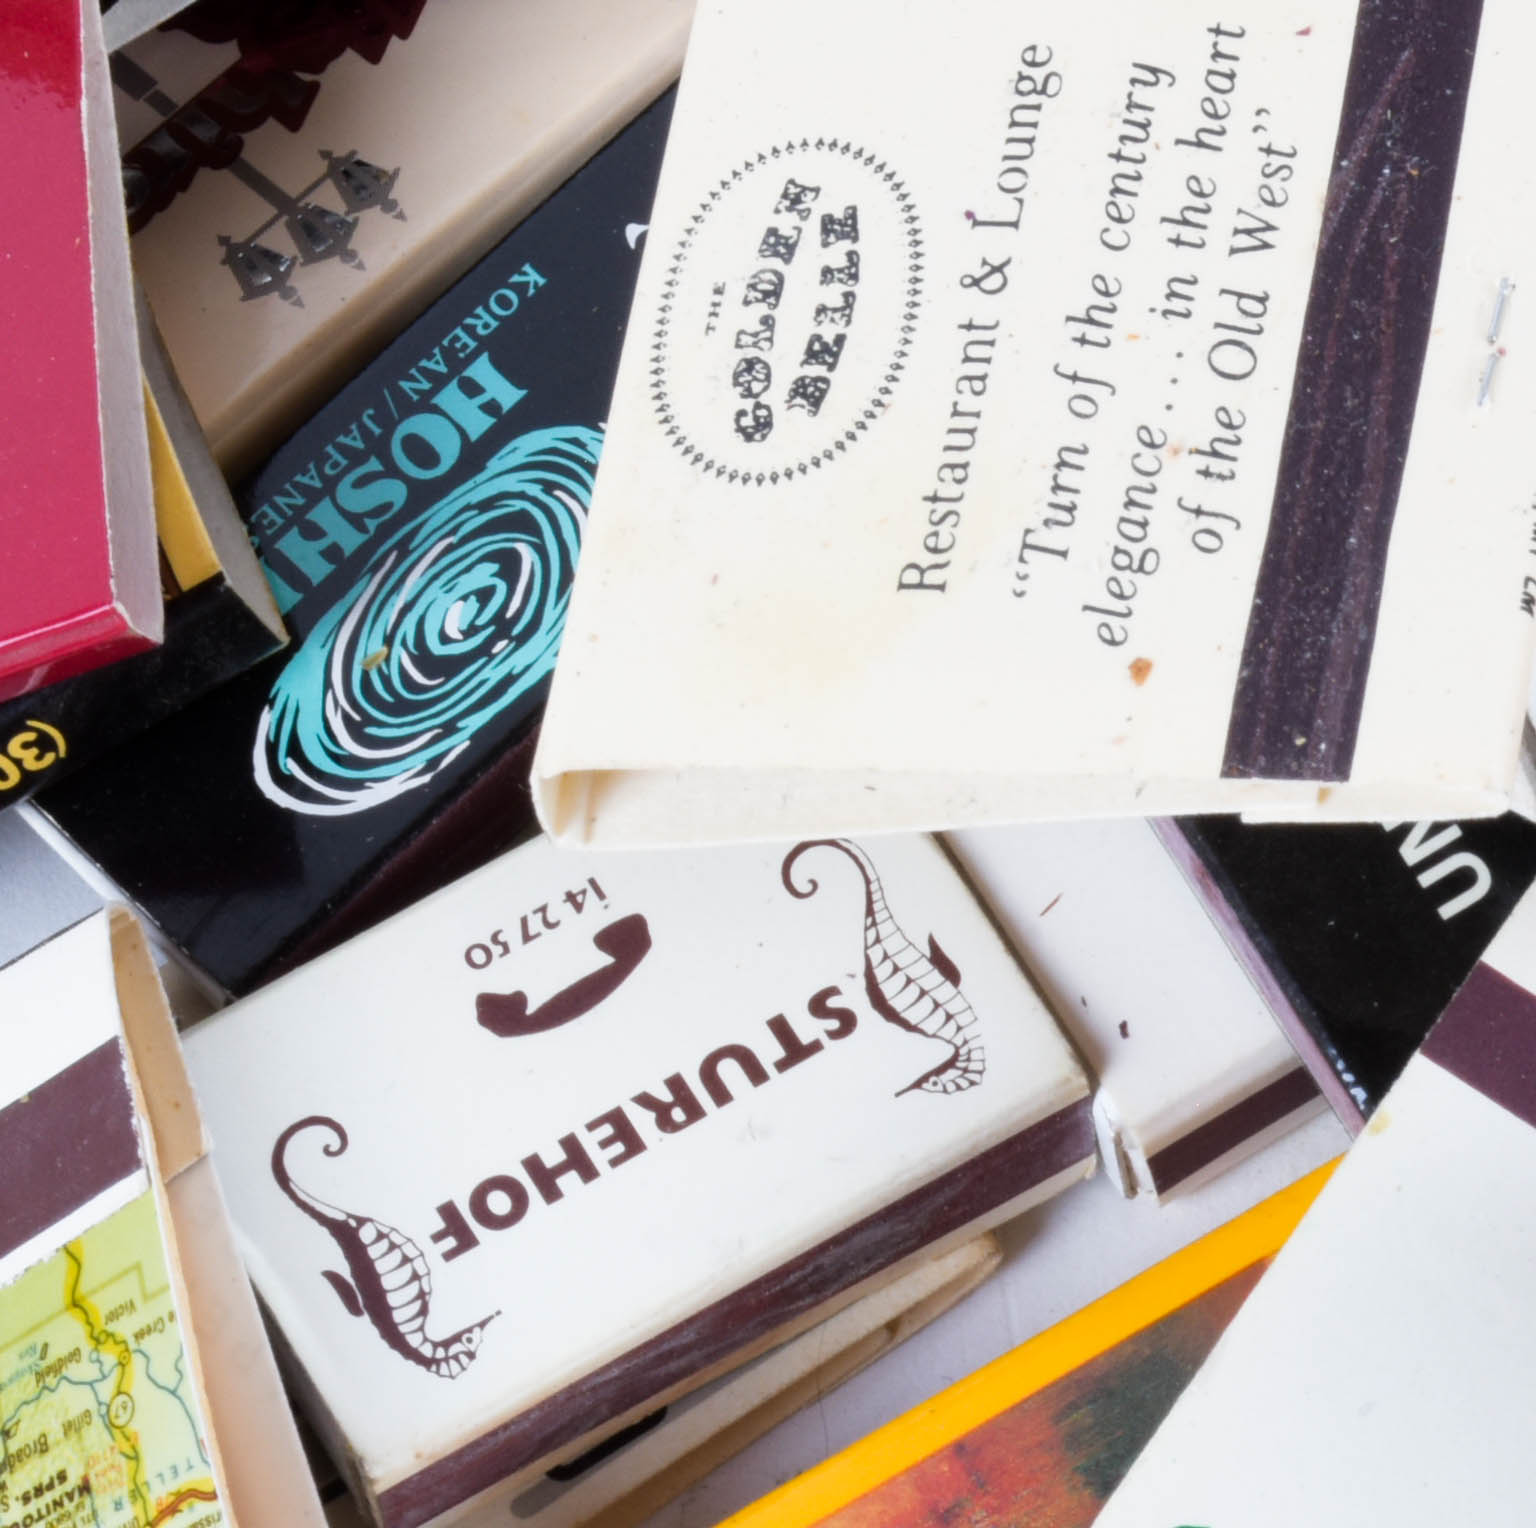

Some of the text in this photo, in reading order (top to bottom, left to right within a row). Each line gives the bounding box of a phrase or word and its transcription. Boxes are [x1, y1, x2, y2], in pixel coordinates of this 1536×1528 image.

[1175, 20, 1247, 155] heart
[1098, 61, 1176, 252] century
[1168, 174, 1219, 251] the
[707, 281, 726, 336] THE
[732, 178, 821, 443] GOLDEN
[785, 204, 861, 416] BELLE
[896, 44, 1063, 594] Restaurant & Lounge
[1071, 273, 1123, 350] the
[1161, 272, 1199, 322] in
[1207, 289, 1268, 384] Old
[1054, 361, 1117, 418] of
[1191, 406, 1247, 482] the
[1175, 496, 1241, 555] of
[463, 927, 512, 972] 50
[519, 899, 564, 949] 27
[429, 983, 860, 1264] STUREHOF
[102, 1296, 136, 1329] Victor
[32, 1345, 82, 1389] Goldfield
[16, 1467, 68, 1510] SPRS.
